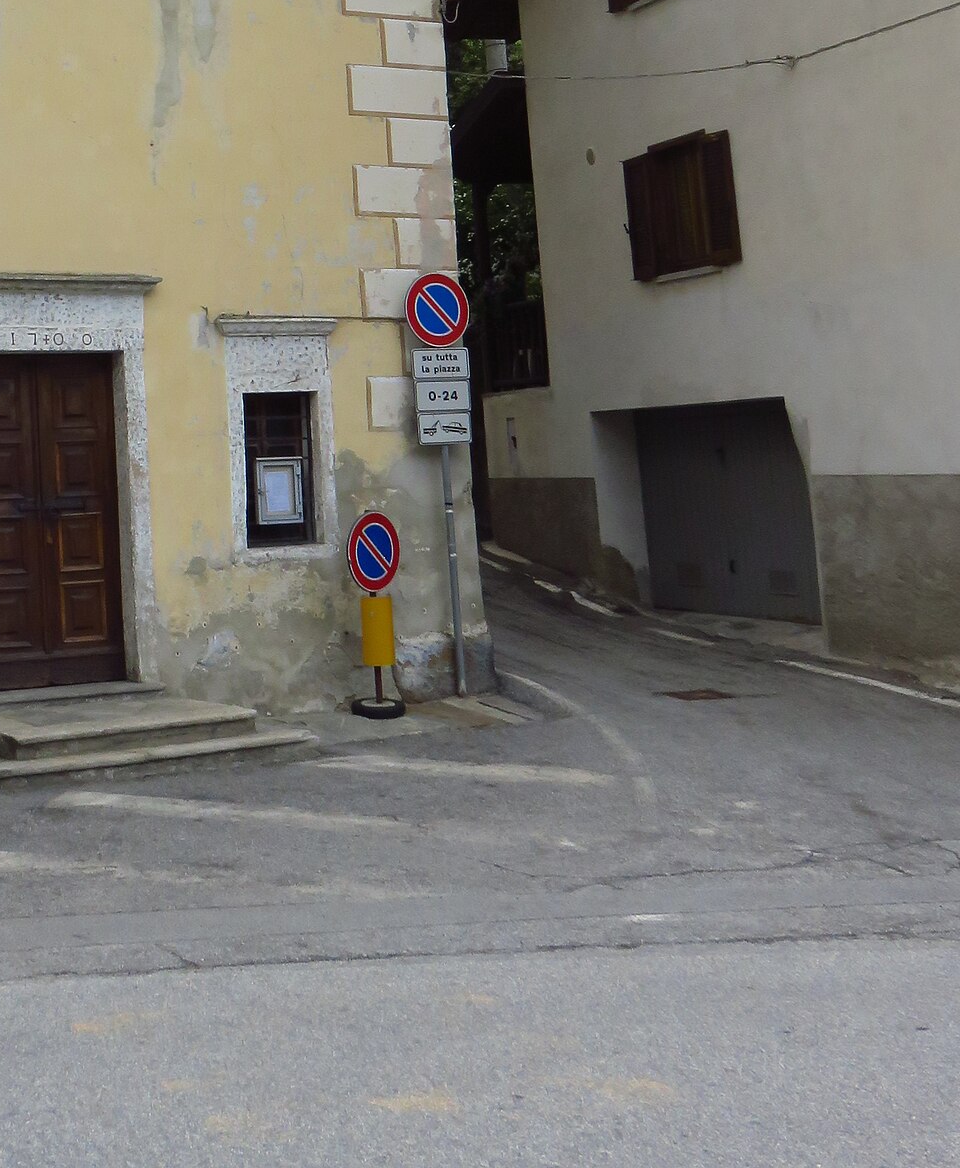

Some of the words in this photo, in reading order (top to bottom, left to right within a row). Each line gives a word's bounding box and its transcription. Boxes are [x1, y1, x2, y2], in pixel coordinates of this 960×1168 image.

[436, 353, 458, 361] tutta
[421, 365, 430, 373] la
[434, 365, 460, 374] piazza
[428, 390, 458, 401] 0-24
